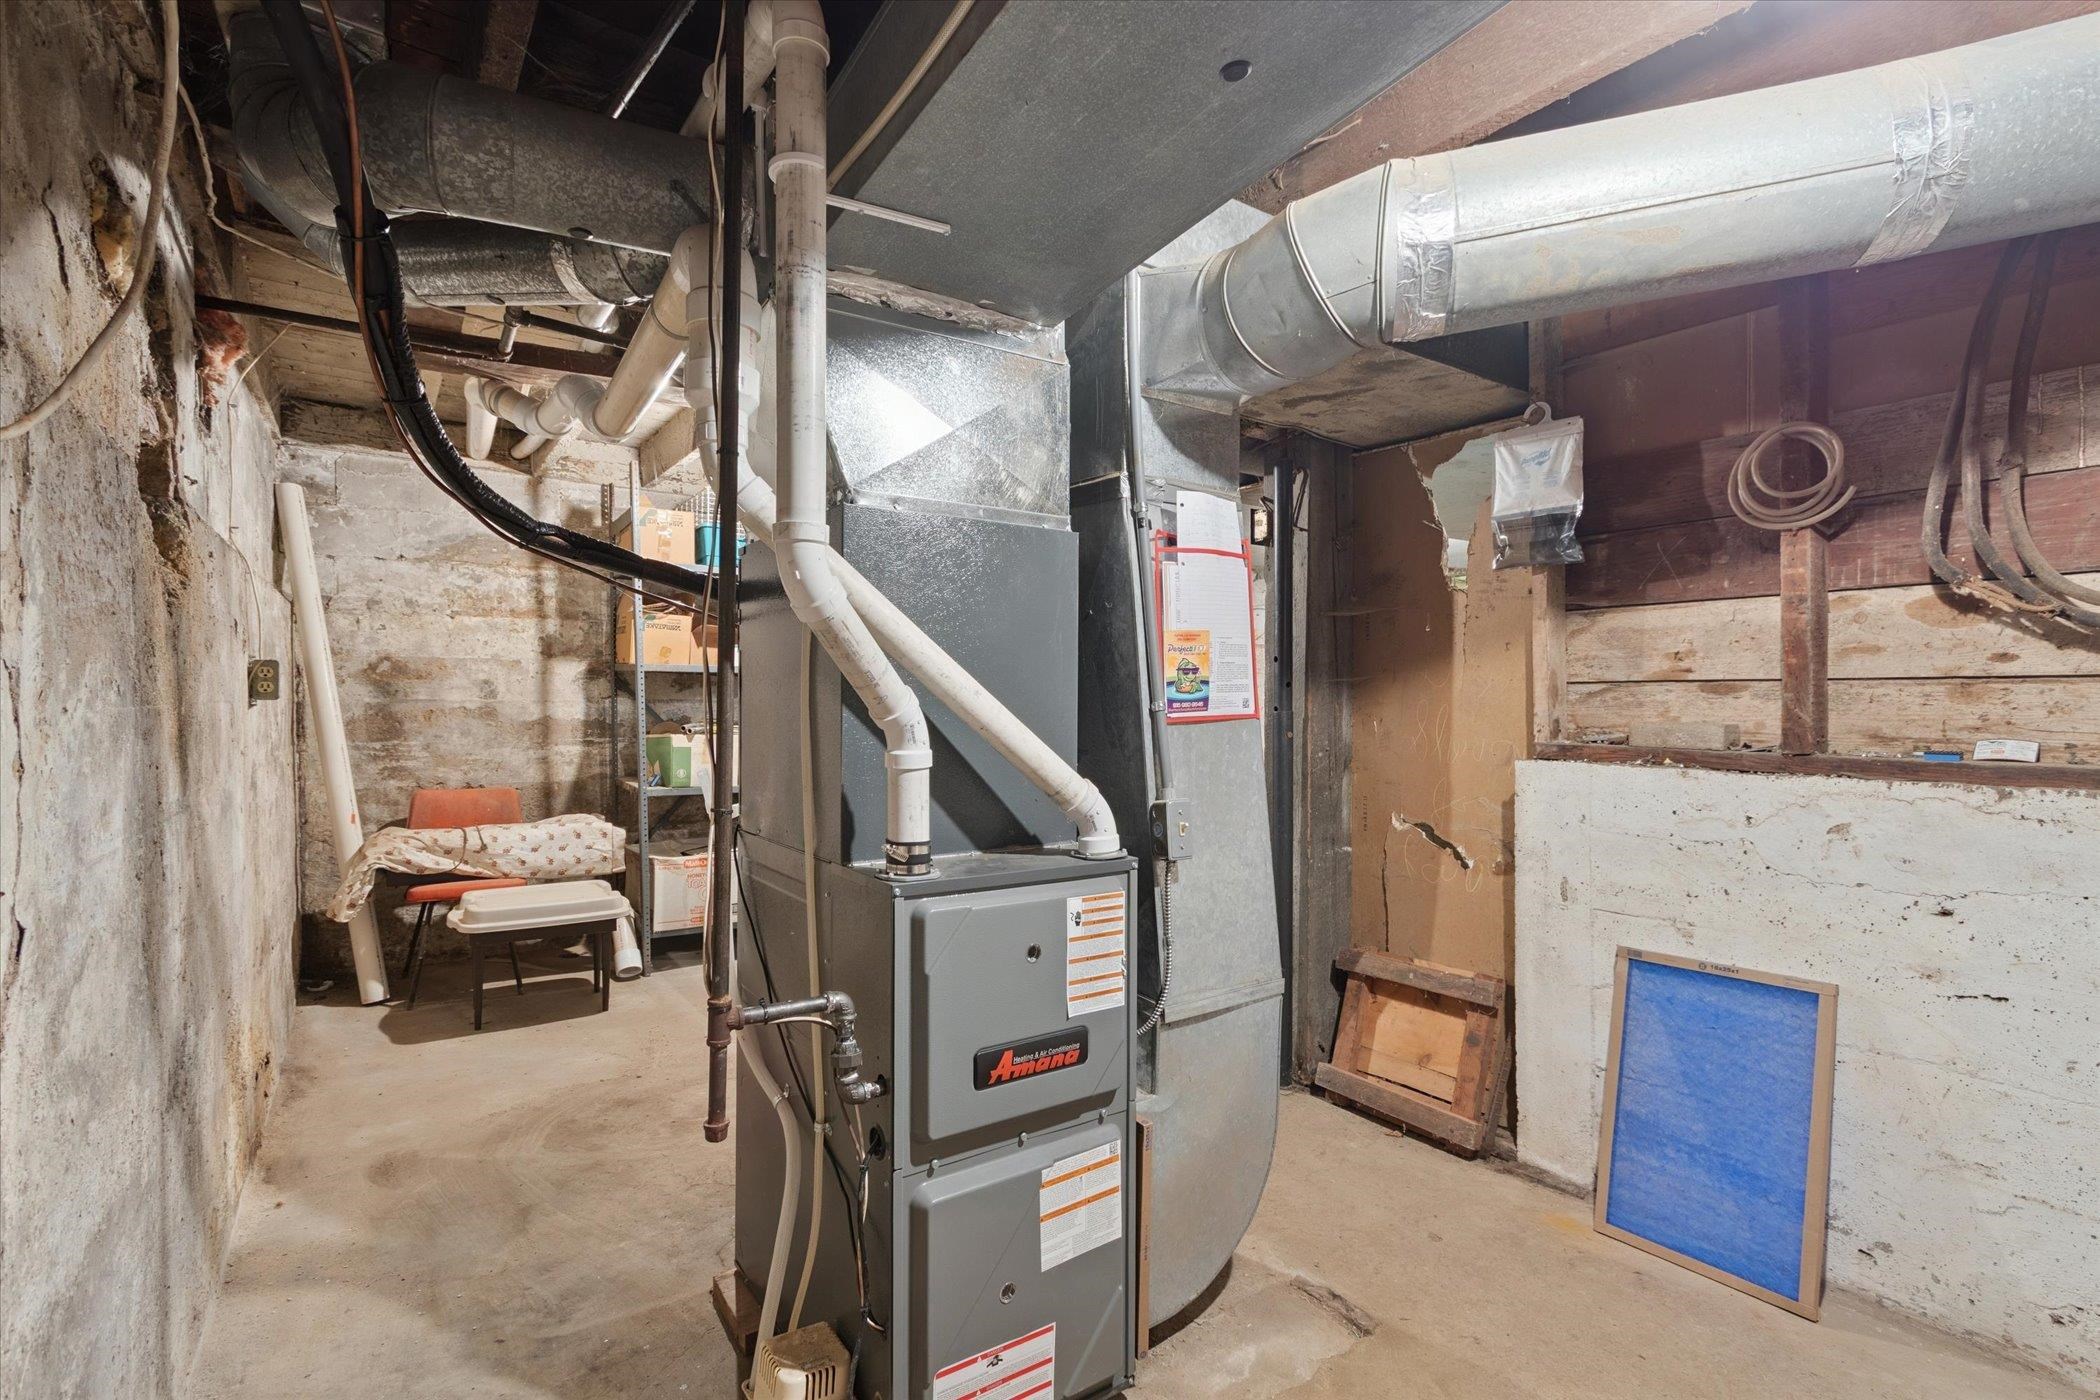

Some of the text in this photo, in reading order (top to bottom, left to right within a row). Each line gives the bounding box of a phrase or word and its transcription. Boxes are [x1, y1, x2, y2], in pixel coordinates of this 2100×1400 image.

[988, 1049, 1080, 1085] Amana
[1013, 1054, 1034, 1065] Heating
[1035, 1051, 1040, 1060] &
[1048, 1043, 1080, 1056] Conditioning
